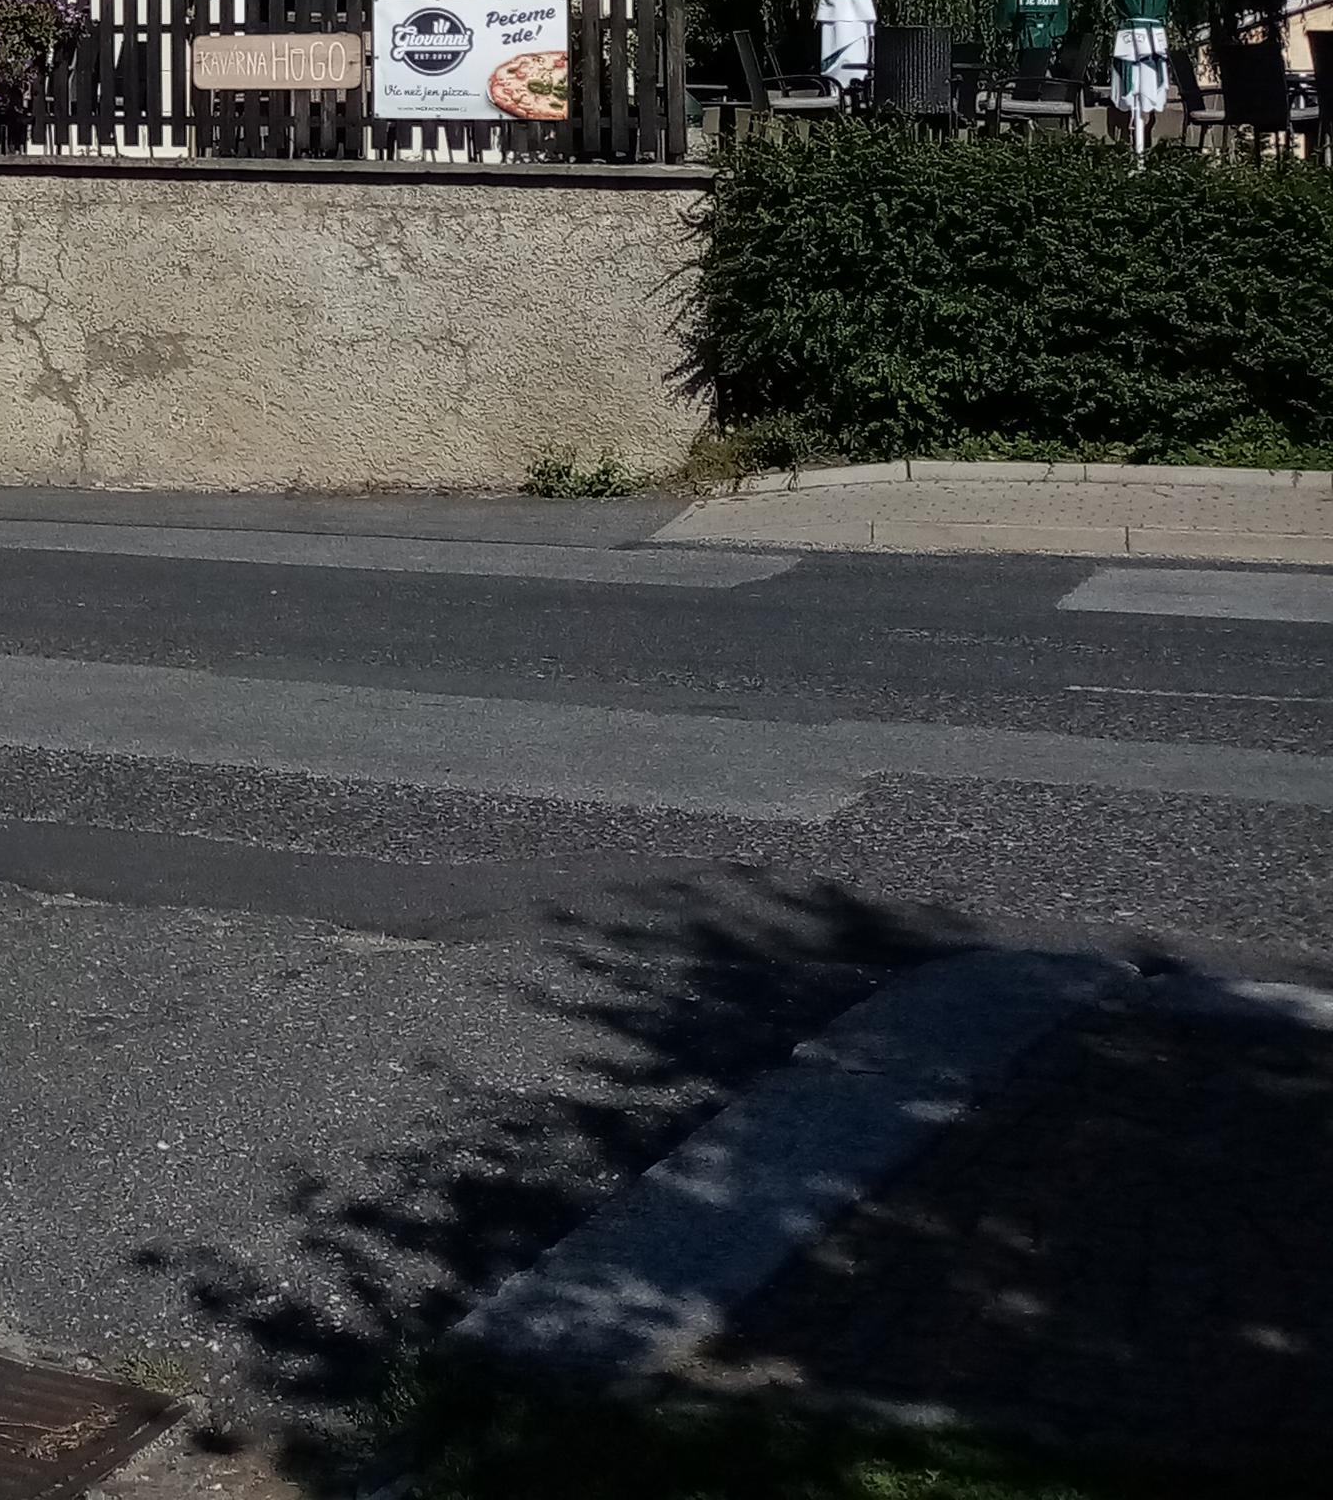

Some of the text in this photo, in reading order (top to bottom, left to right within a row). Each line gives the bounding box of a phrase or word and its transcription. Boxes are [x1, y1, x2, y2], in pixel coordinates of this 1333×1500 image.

[485, 7, 556, 28] Pečeme
[393, 25, 471, 57] Giovanni
[501, 24, 543, 45] zde!
[200, 44, 268, 77] KAVÁRNA
[384, 84, 402, 96] Víc
[404, 85, 422, 97] než
[421, 87, 439, 101] jen
